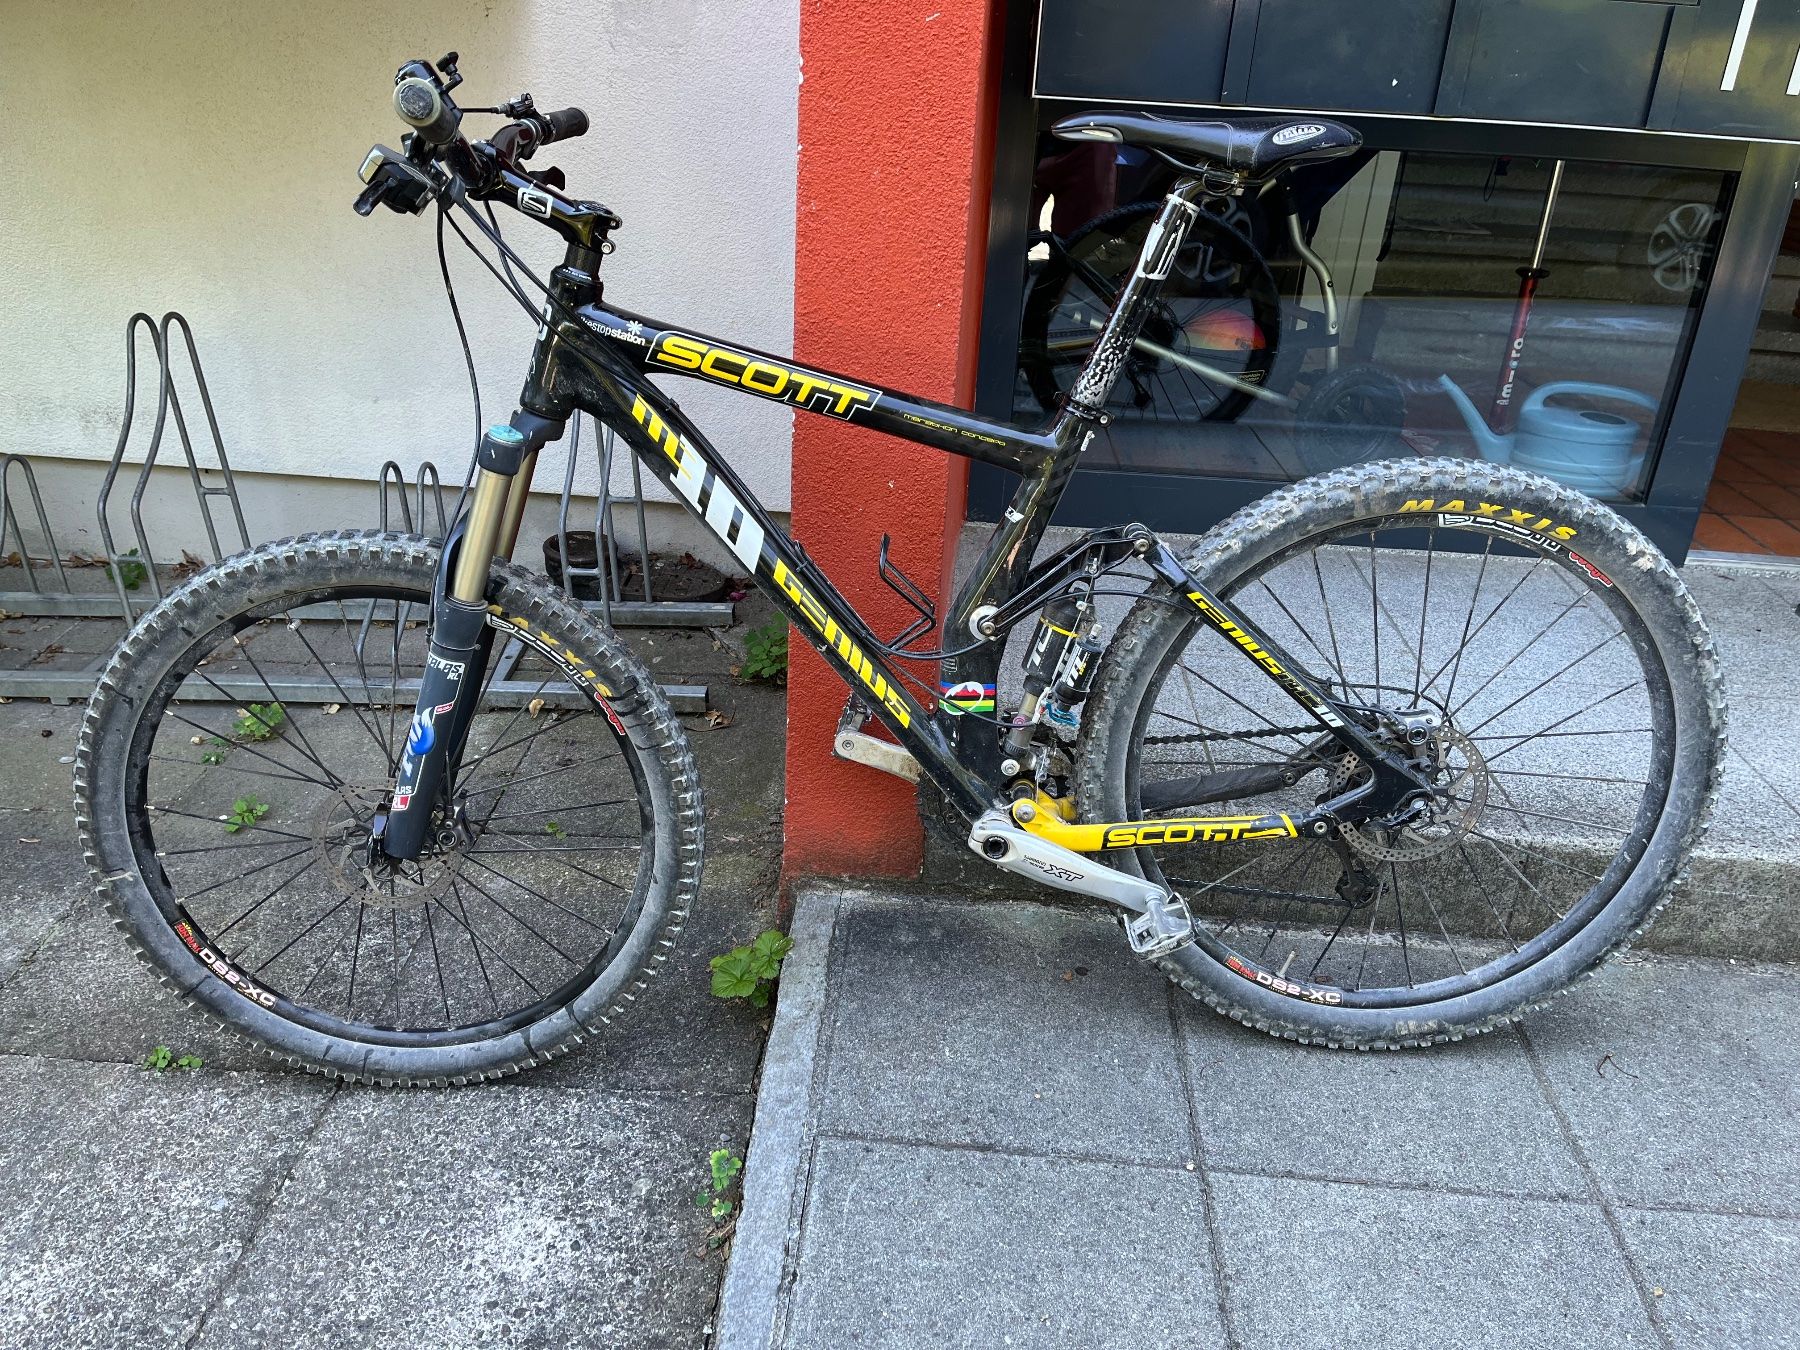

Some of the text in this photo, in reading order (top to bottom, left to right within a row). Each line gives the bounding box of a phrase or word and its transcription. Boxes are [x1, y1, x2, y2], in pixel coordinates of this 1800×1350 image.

[656, 336, 870, 415] SCOTT
[1397, 499, 1579, 540] MAXXIS
[395, 785, 412, 794] LAS
[1106, 823, 1253, 848] SCOTT
[1043, 863, 1085, 881] XT
[199, 947, 276, 1006] DS2-XC
[1256, 971, 1341, 1003] DS2-XC
